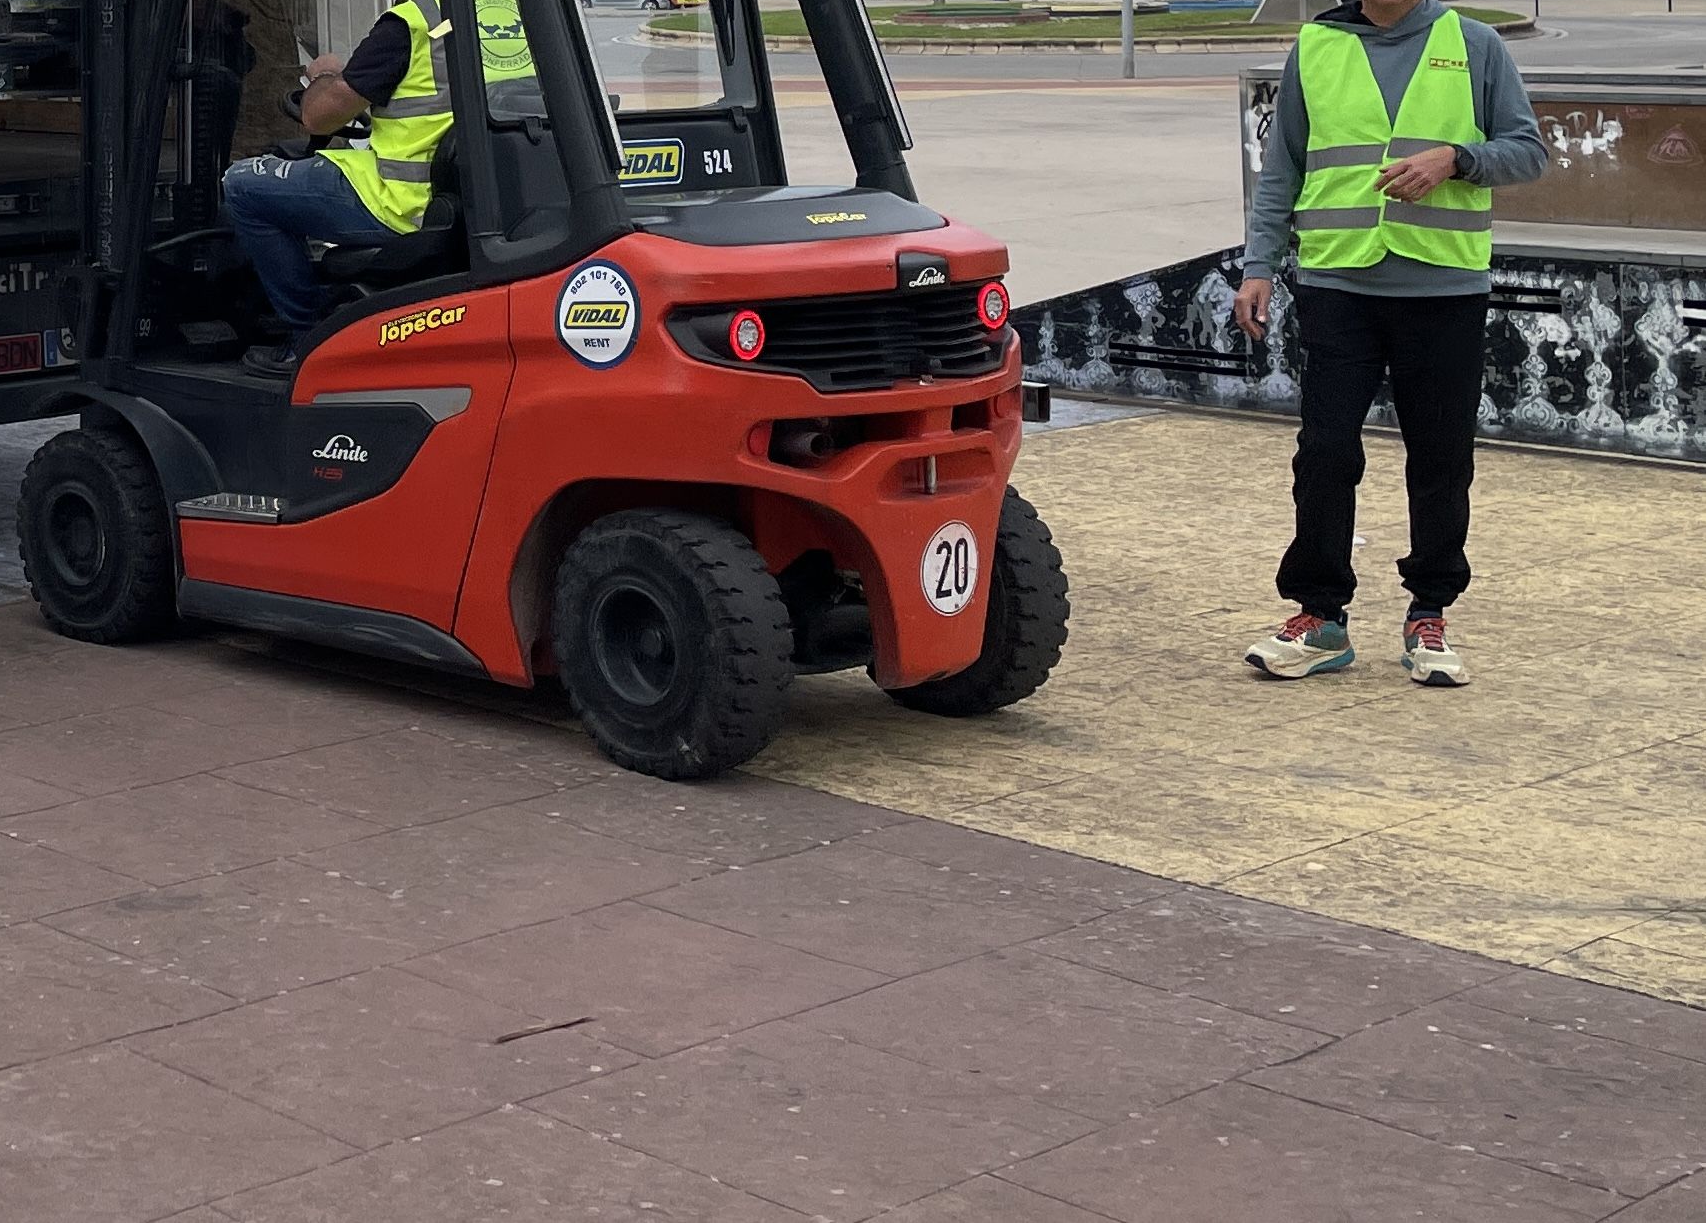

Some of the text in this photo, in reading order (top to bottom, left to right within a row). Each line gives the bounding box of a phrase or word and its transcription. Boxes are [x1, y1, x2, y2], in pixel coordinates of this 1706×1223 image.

[703, 149, 733, 175] 524
[589, 270, 608, 281] 101
[908, 266, 946, 288] Linde
[379, 306, 466, 346] JopeCar
[583, 338, 611, 348] RENT
[312, 434, 369, 463] Linde
[935, 537, 969, 599] 20
